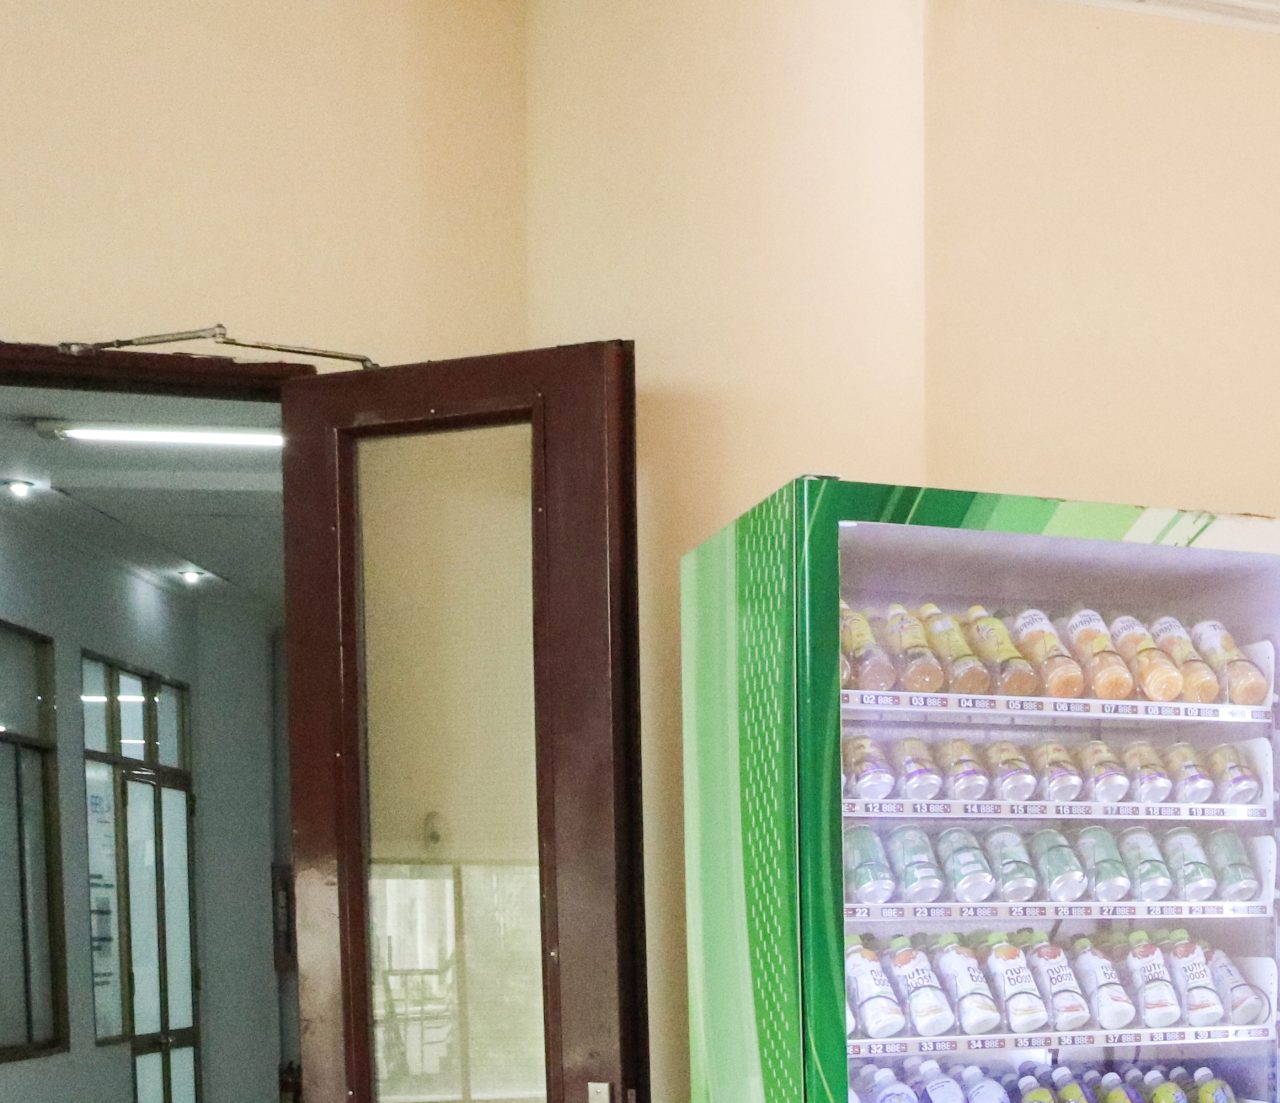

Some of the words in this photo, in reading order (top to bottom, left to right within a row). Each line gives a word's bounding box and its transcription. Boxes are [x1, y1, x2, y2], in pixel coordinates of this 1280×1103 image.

[863, 695, 875, 703] 02
[912, 697, 924, 705] 03
[961, 699, 973, 707] 04
[1009, 701, 1021, 709] 05
[868, 804, 879, 812] 12
[915, 804, 927, 813] 13
[967, 805, 978, 813] 14
[916, 908, 928, 916] 23
[922, 1042, 934, 1050] 33
[1018, 1039, 1029, 1047] 35
[871, 1045, 883, 1053] 32
